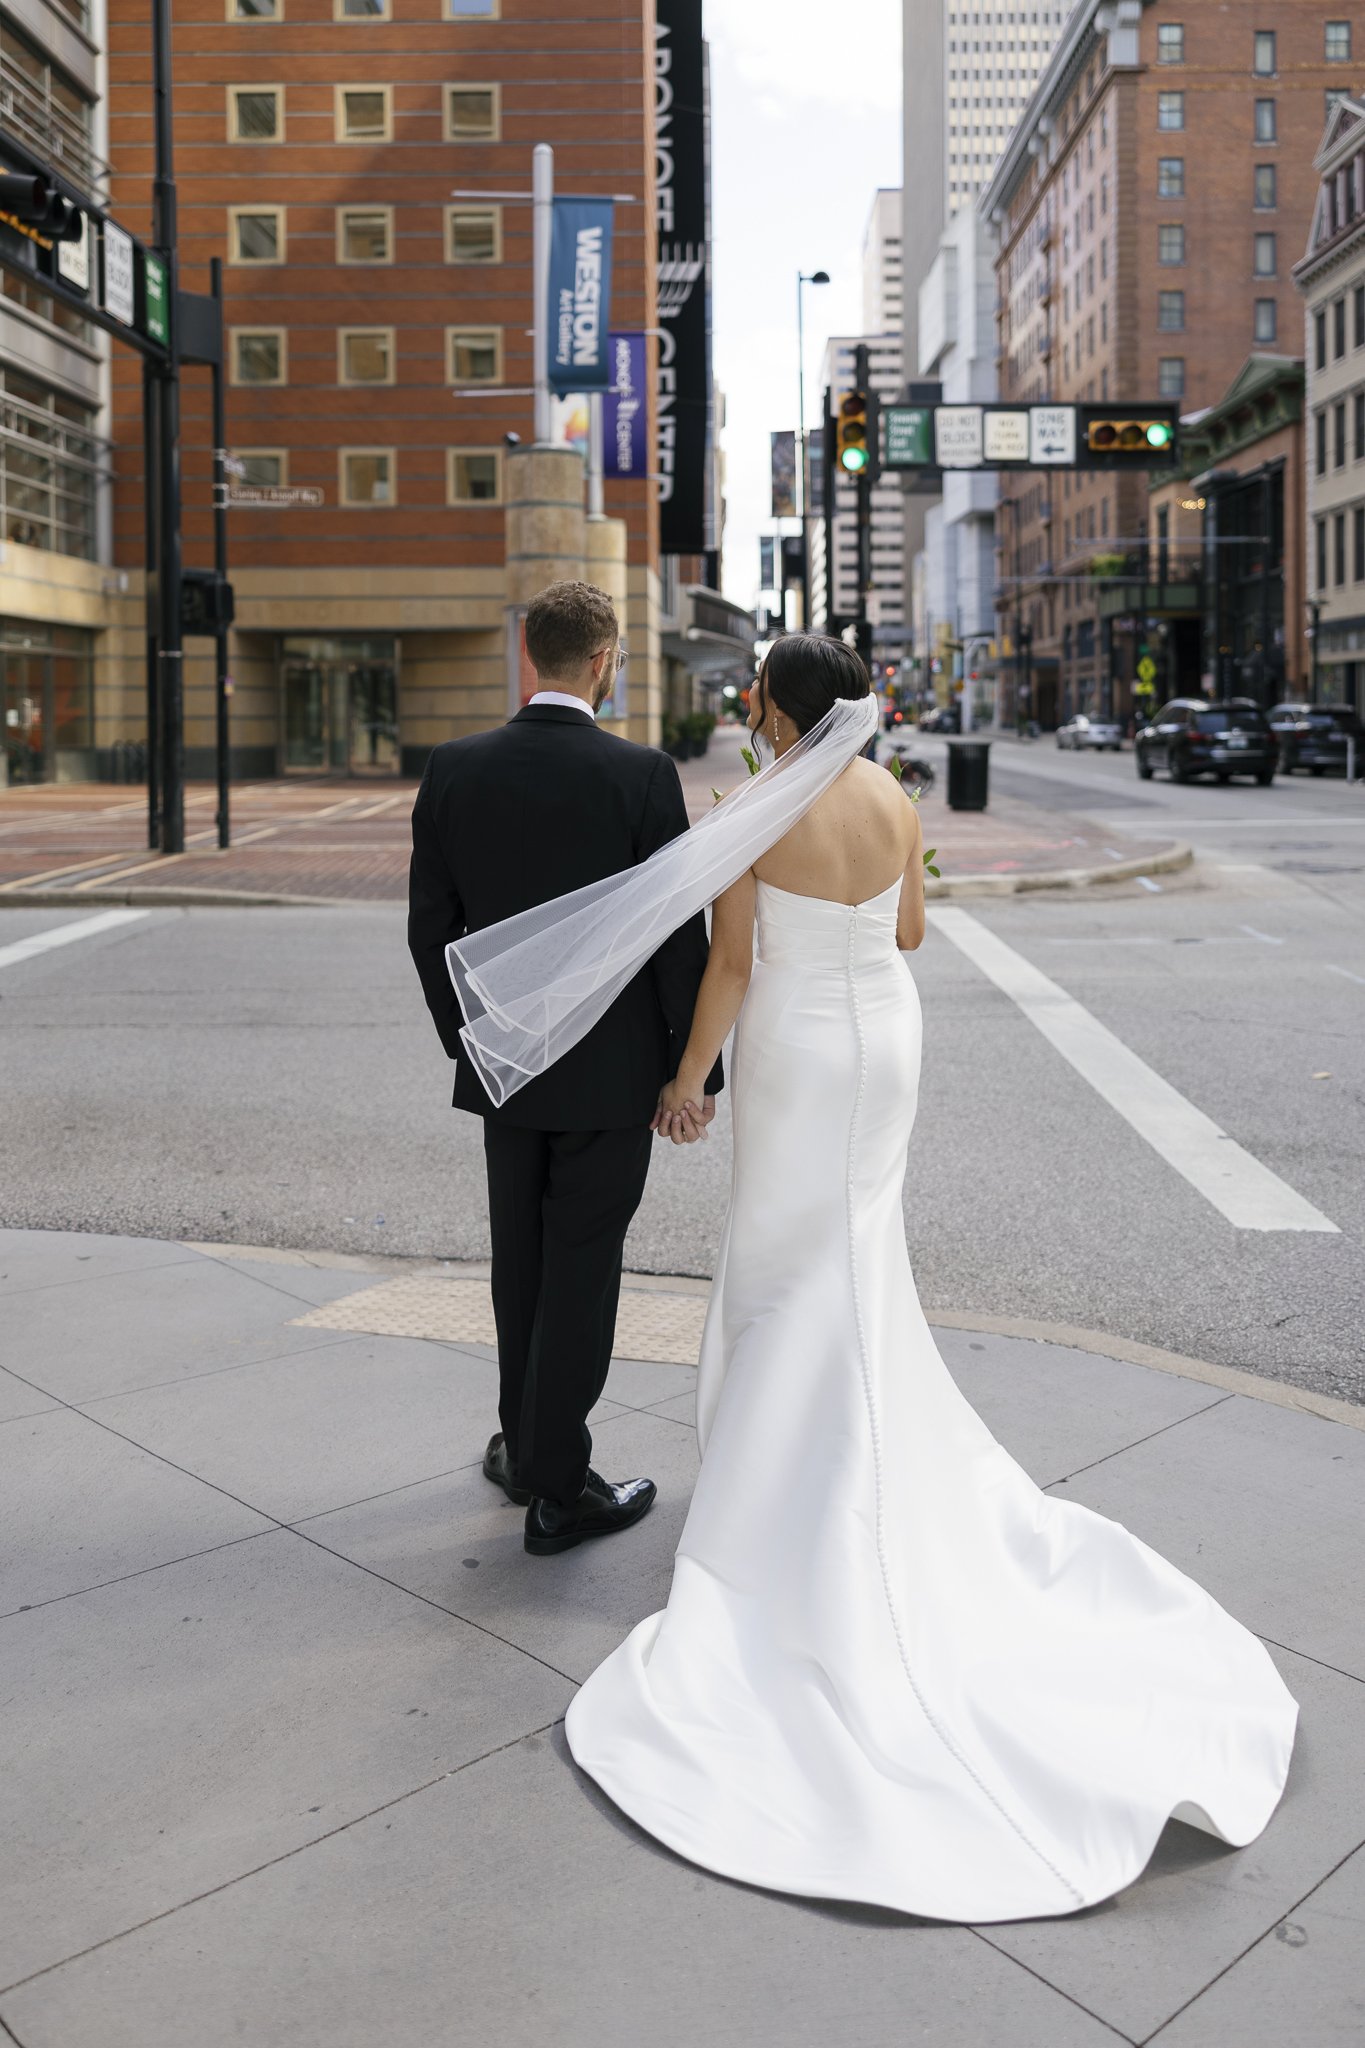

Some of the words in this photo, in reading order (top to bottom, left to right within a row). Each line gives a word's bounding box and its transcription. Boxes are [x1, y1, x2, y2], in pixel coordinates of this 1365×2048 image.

[559, 288, 574, 312] Art
[573, 225, 603, 367] WESTON
[556, 314, 573, 366] Gallery
[1037, 412, 1065, 424] ONE
[944, 431, 976, 445] BLOCK
[1038, 427, 1066, 440] WAY
